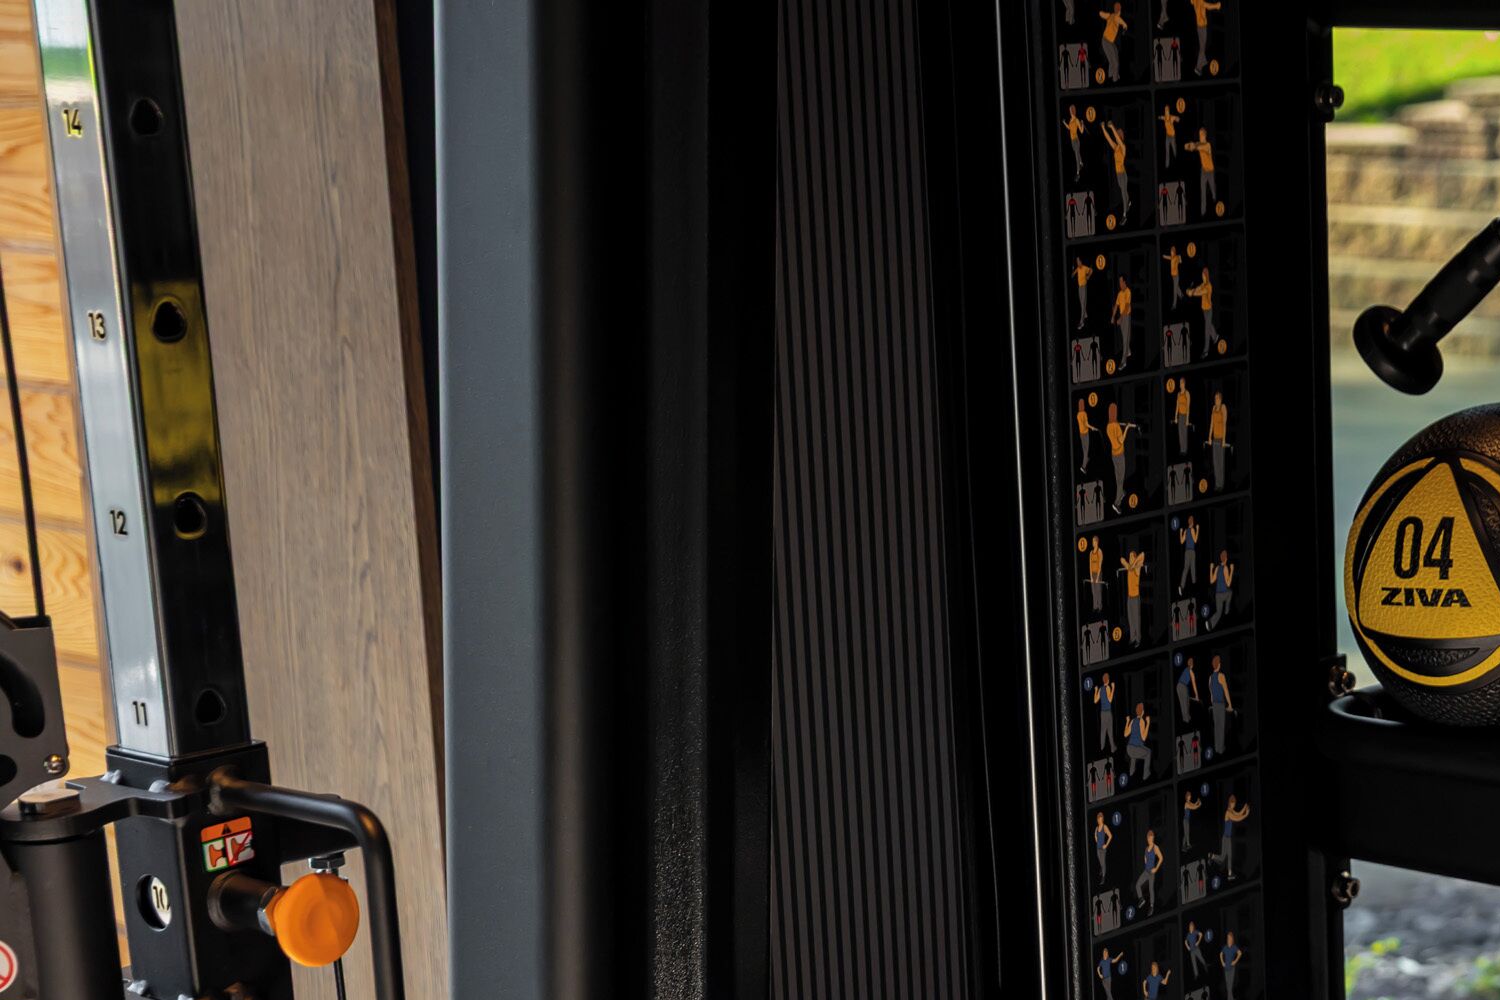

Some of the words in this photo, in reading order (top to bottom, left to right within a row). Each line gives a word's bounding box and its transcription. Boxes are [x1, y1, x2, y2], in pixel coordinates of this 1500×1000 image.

[63, 109, 82, 136] 14
[88, 312, 107, 339] 13
[109, 510, 128, 535] 12
[1393, 515, 1455, 580] 04
[1381, 587, 1472, 607] ZIVA
[132, 700, 148, 726] 11
